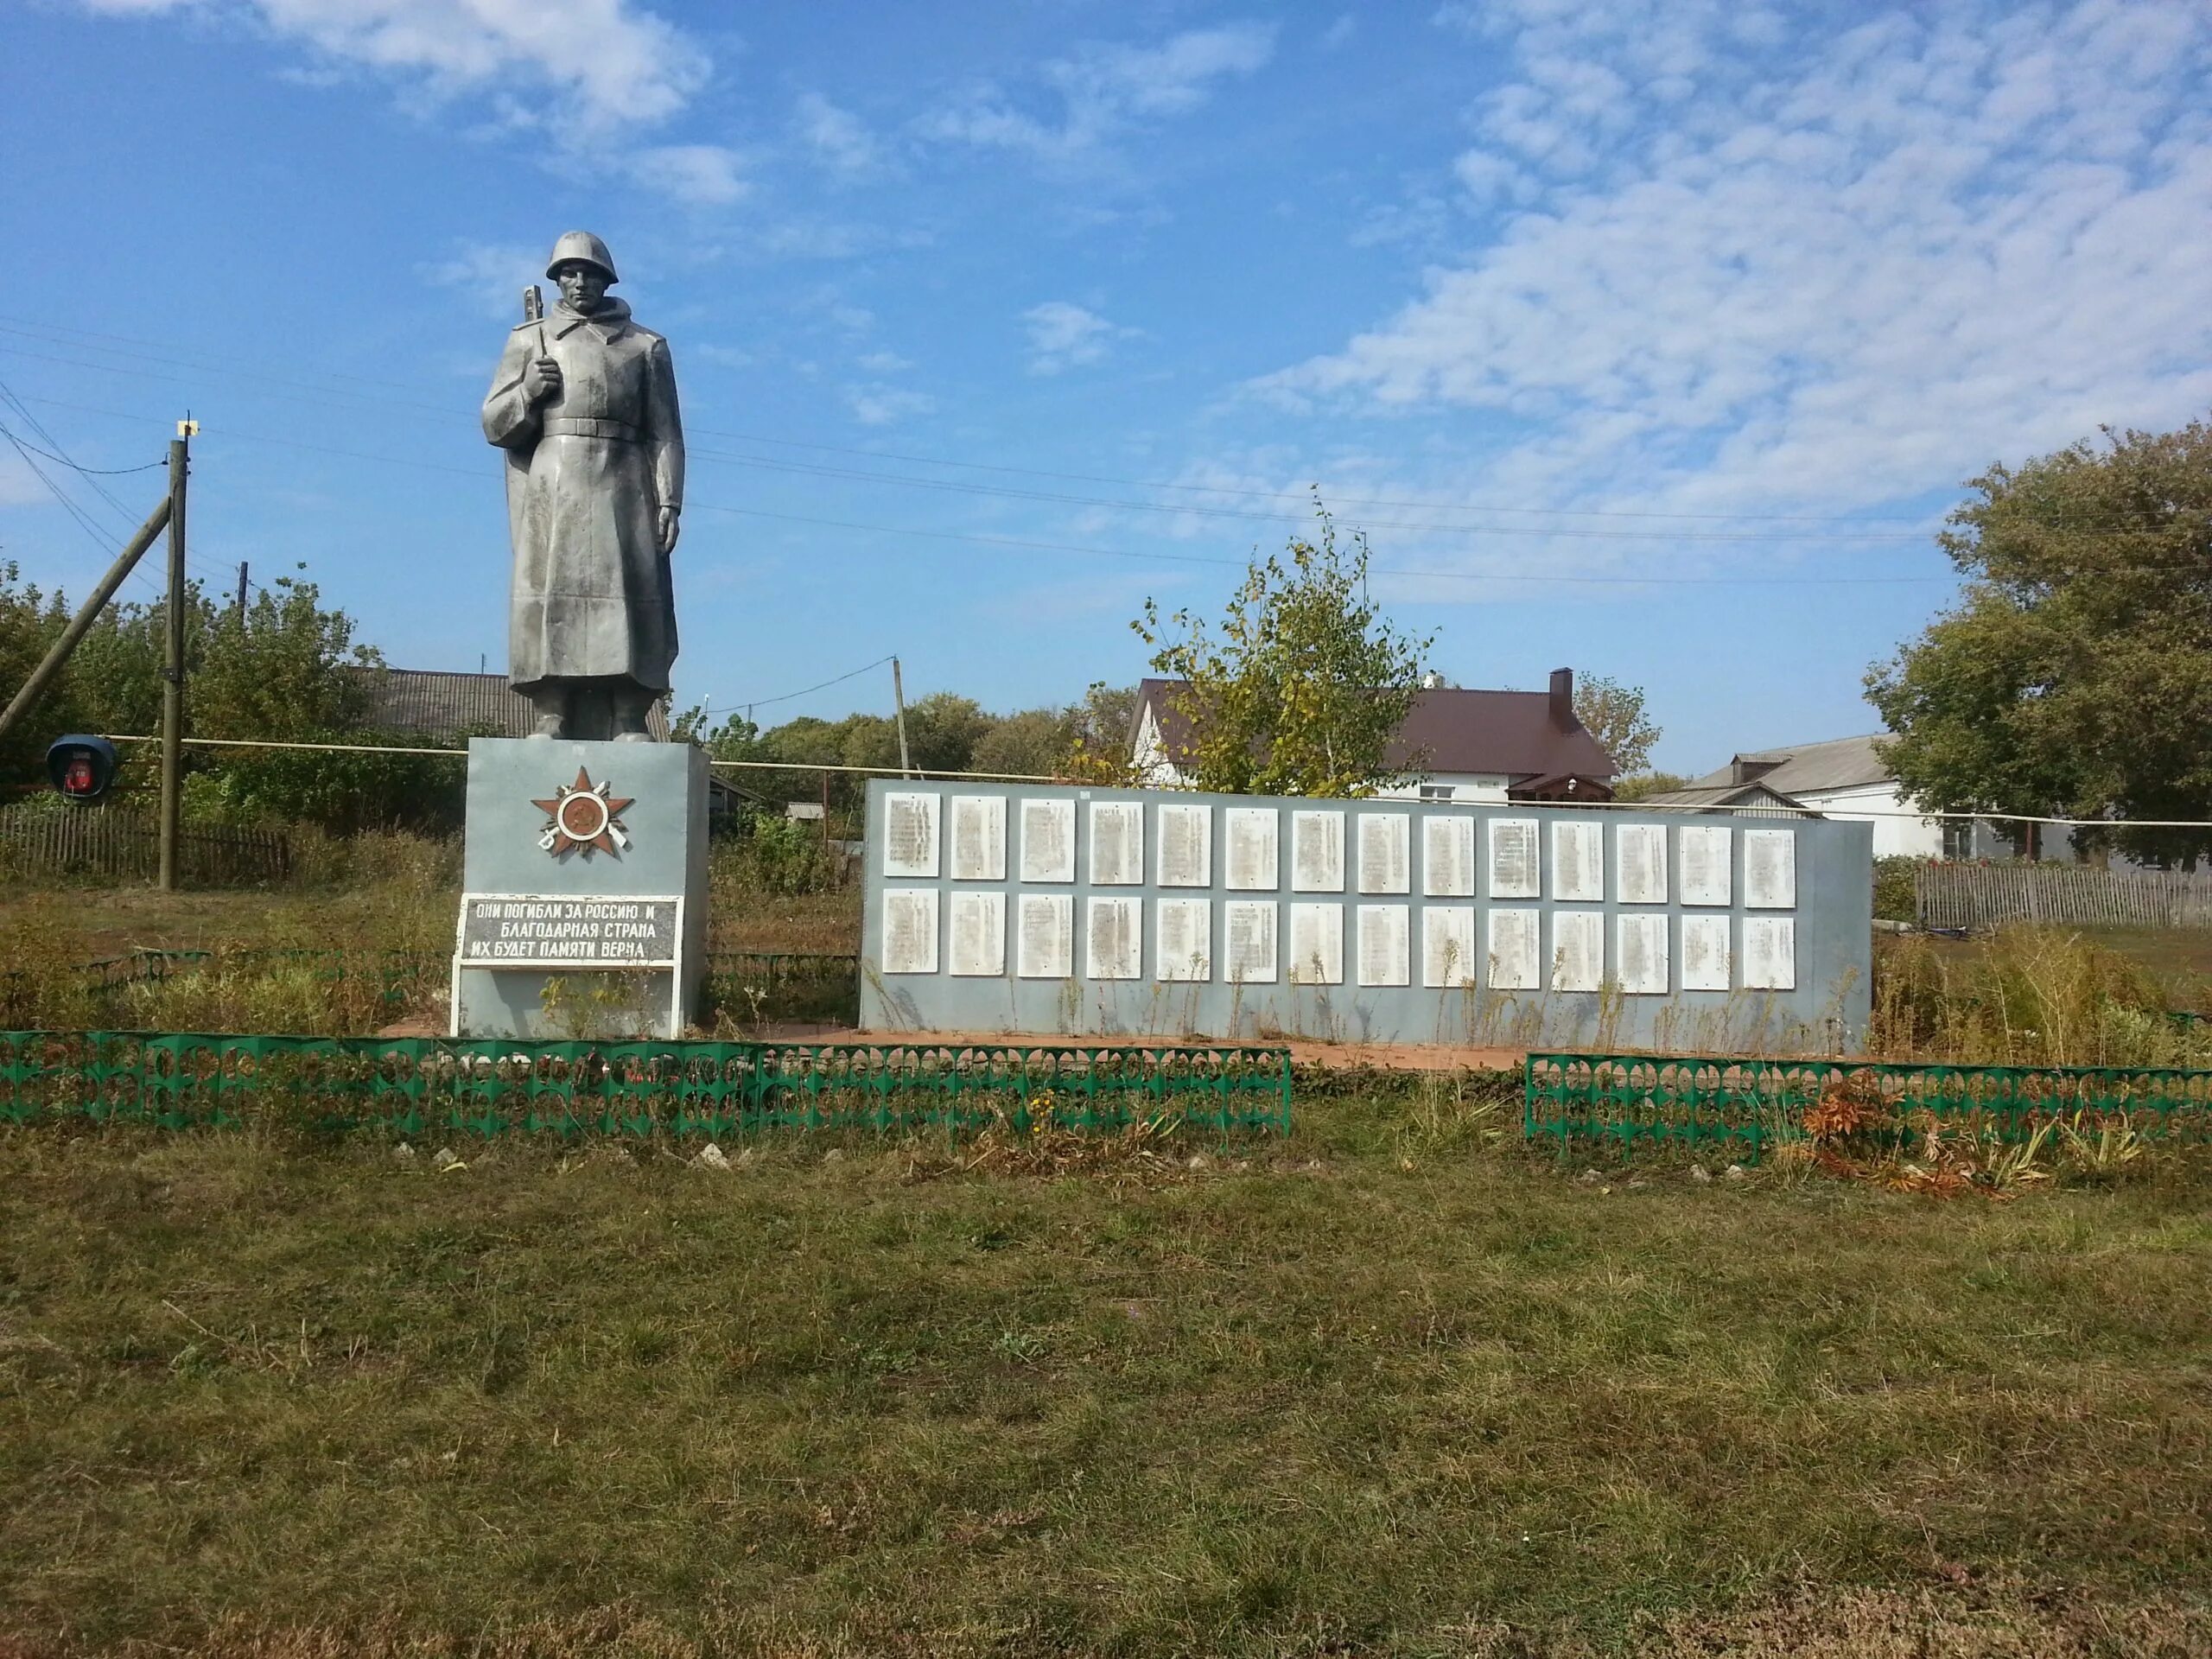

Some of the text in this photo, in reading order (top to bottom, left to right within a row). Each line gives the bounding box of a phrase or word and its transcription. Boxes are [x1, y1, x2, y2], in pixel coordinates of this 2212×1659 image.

[477, 904, 655, 919] ОНИ ПОГИБЛИ ЗА РОССИЮ И
[500, 922, 656, 938] БЛАГОДАРНАЯ СТРАНА
[470, 941, 645, 957] ИХ БУДЕТ ПАМЯТИ ВЕРНА
